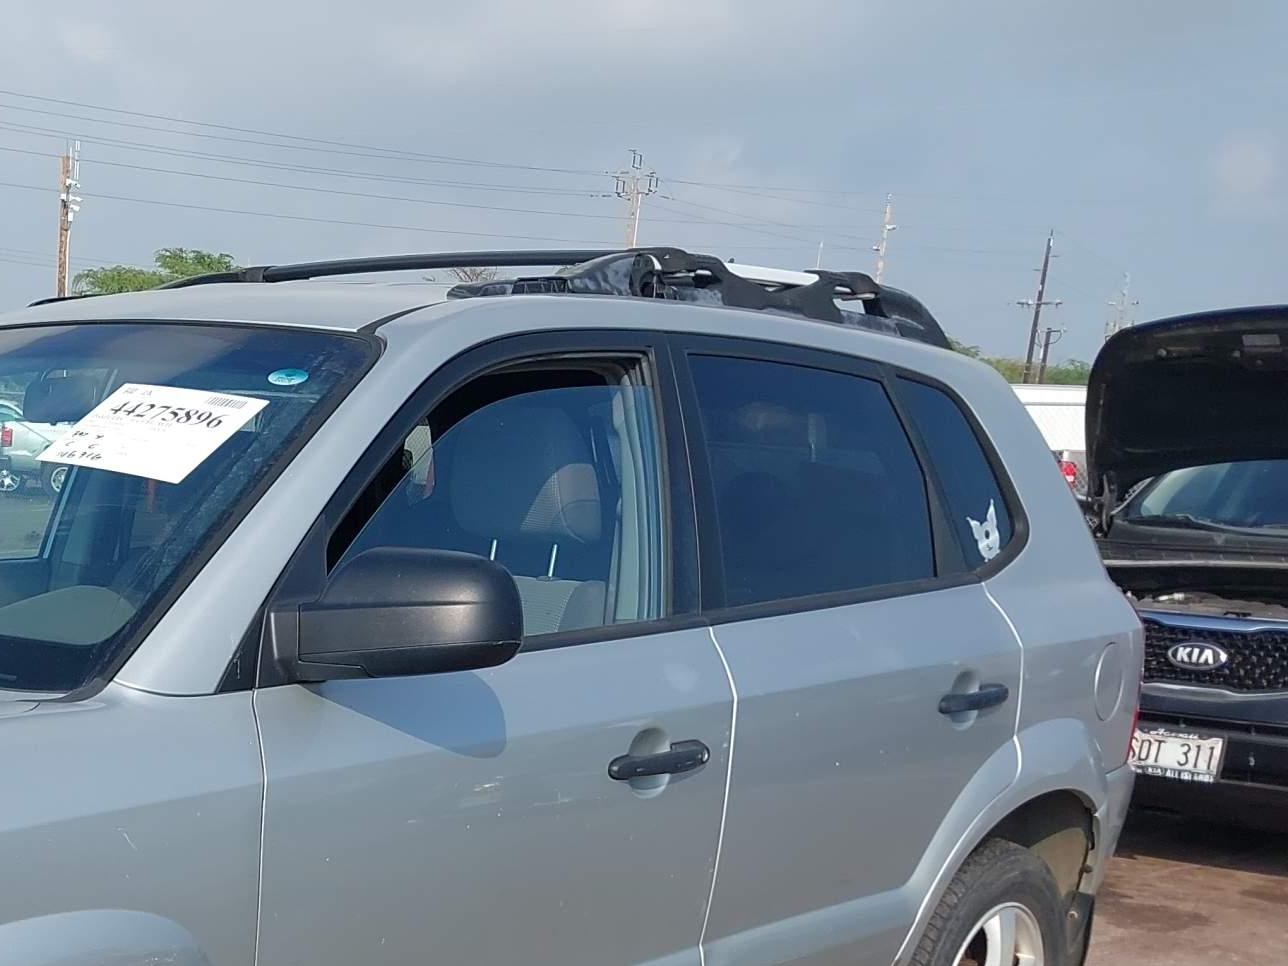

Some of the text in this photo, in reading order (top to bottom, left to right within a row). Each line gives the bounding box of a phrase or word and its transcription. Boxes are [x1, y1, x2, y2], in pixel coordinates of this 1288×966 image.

[111, 400, 225, 429] 44275896
[1176, 646, 1214, 665] KIA
[1177, 743, 1215, 770] 311
